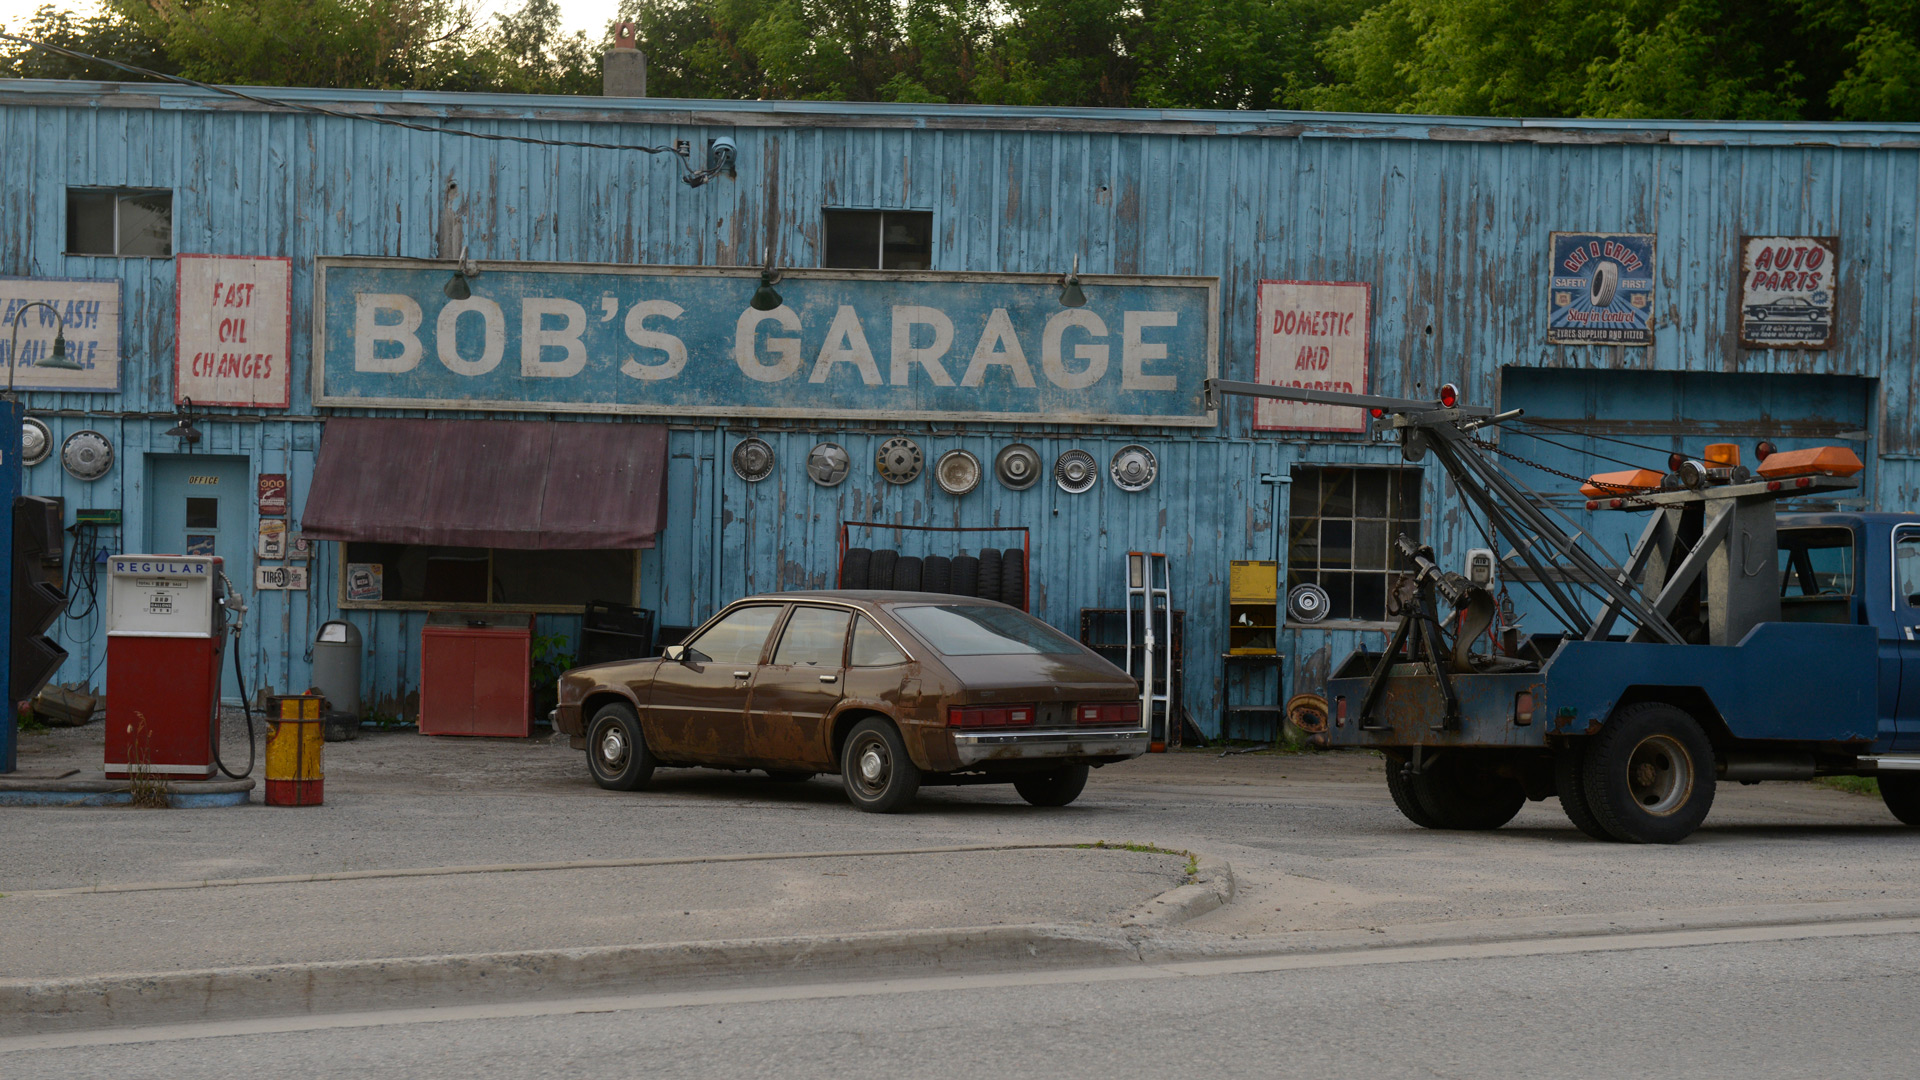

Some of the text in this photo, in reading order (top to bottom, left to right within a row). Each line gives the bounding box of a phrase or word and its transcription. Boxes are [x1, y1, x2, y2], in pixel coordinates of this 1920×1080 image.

[1563, 240, 1643, 273] GET A GRIP!
[1754, 246, 1825, 271] AUTO
[1555, 278, 1647, 289] SAFETY FIRST
[1751, 271, 1823, 292] PARTS
[213, 283, 255, 309] FAST
[0, 299, 101, 330] AR WASH
[1273, 309, 1354, 337] DOMESTIC
[1567, 308, 1635, 325] Stay in Control
[219, 318, 248, 344] OIL
[354, 292, 1179, 391] BOB'S GARAGE
[1556, 329, 1645, 340] TYRES SUPPLIED AND FITTED
[192, 352, 273, 380] CHANGES
[1295, 346, 1330, 371] AND
[188, 476, 219, 485] OFFICE
[261, 480, 284, 488] GAS
[117, 562, 204, 574] REGULAR
[262, 571, 281, 583] TIRES
